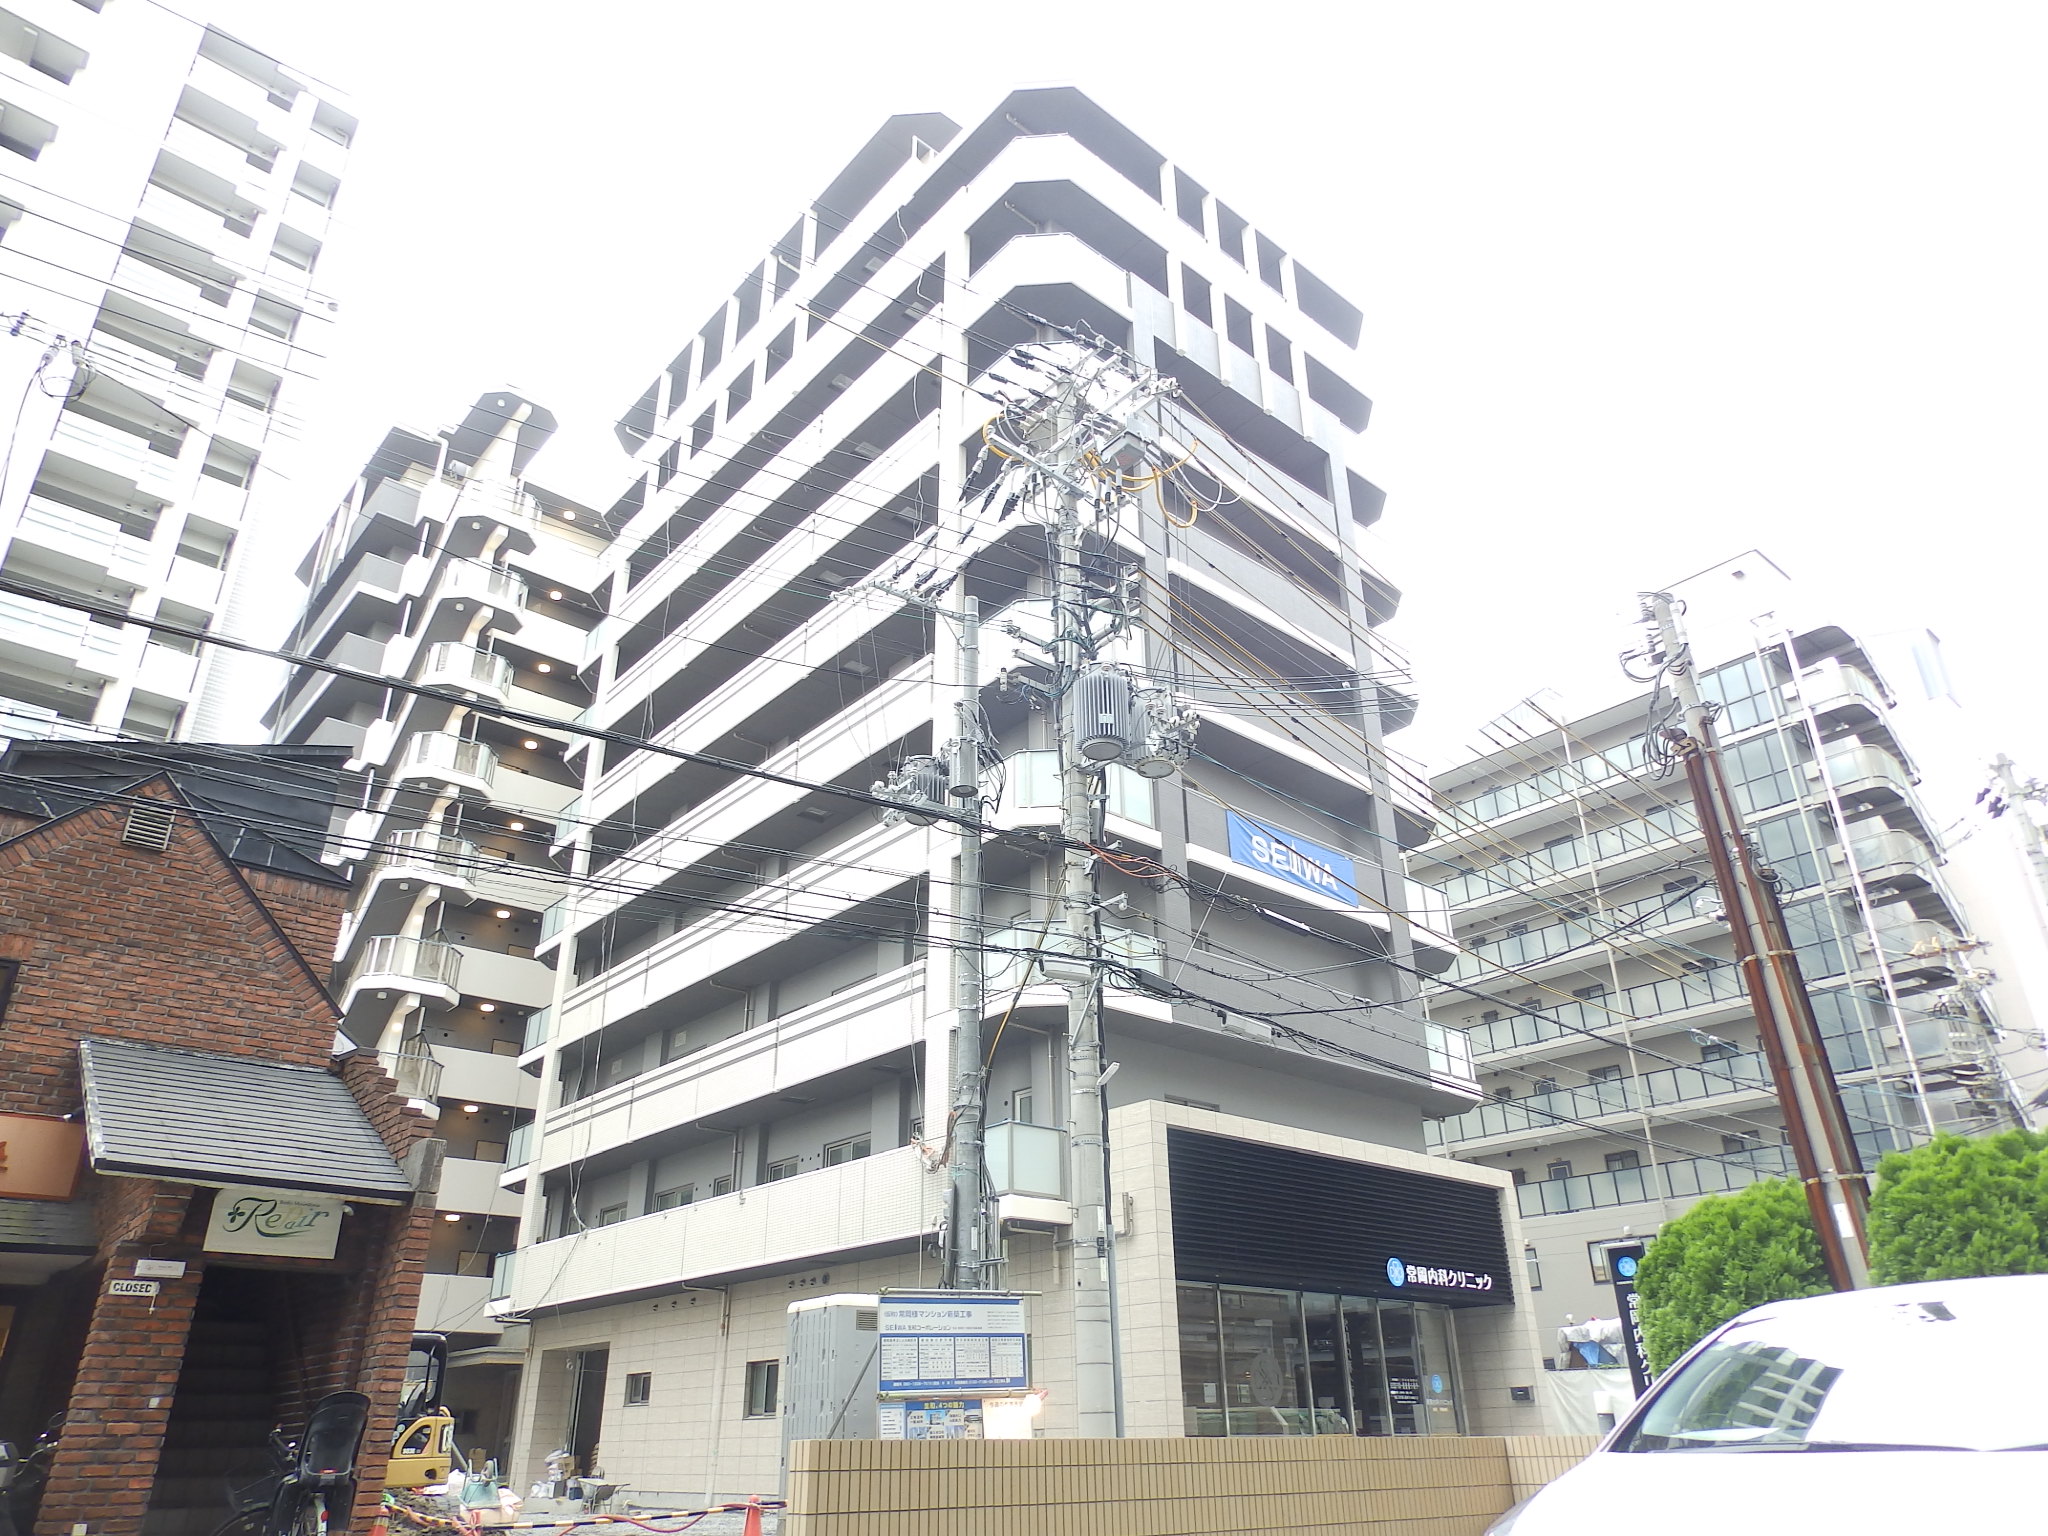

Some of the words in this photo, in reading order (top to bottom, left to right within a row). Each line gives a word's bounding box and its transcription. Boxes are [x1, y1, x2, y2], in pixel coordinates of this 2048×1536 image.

[1251, 835, 1338, 891] SEIWA
[113, 1281, 153, 1294] CLOSED
[1406, 1265, 1492, 1290] 常岡内科クリニック
